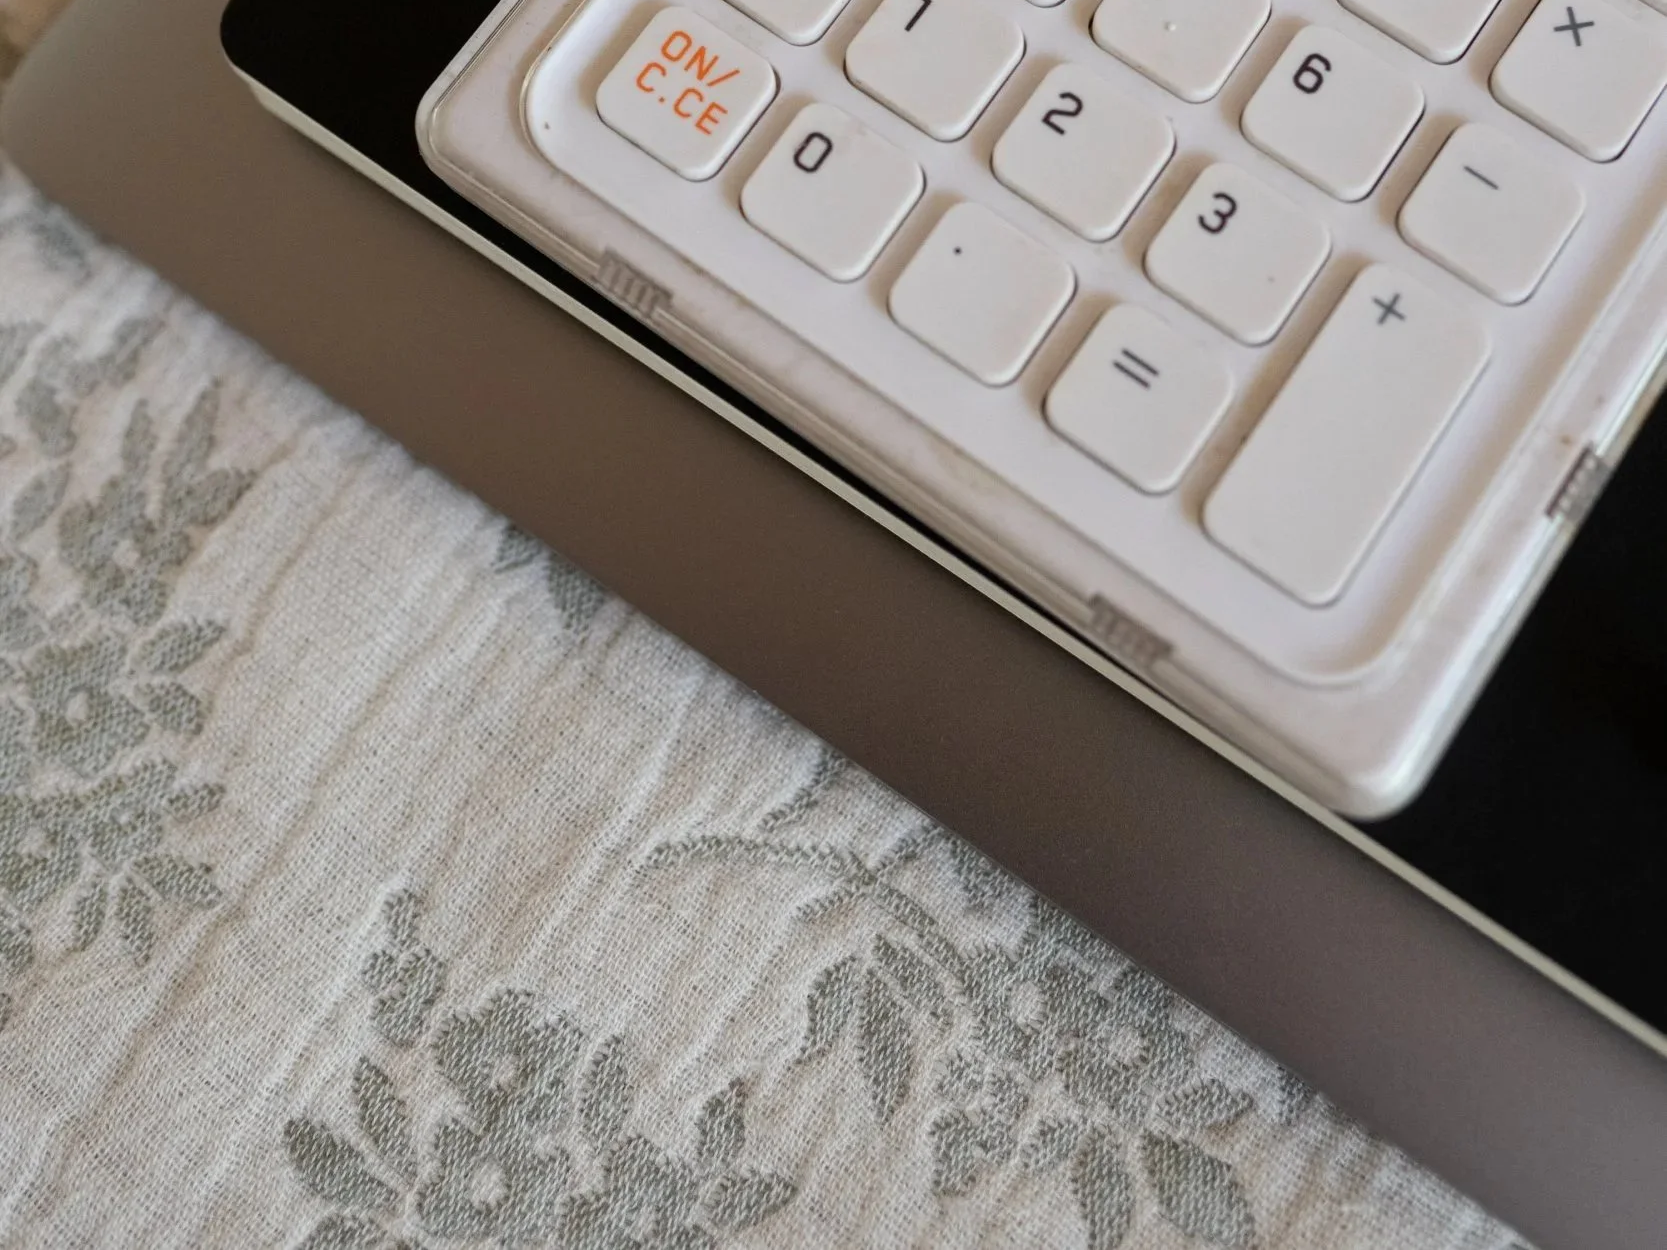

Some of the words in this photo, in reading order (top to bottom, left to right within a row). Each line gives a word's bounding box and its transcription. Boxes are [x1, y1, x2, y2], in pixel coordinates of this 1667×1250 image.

[660, 29, 741, 89] ON/
[1291, 52, 1333, 95] 6
[635, 61, 729, 137] C.CE
[1041, 91, 1085, 137] 2
[792, 131, 834, 175] 0
[1197, 191, 1239, 236] 3
[1372, 292, 1406, 326] +
[1112, 348, 1160, 390] =
